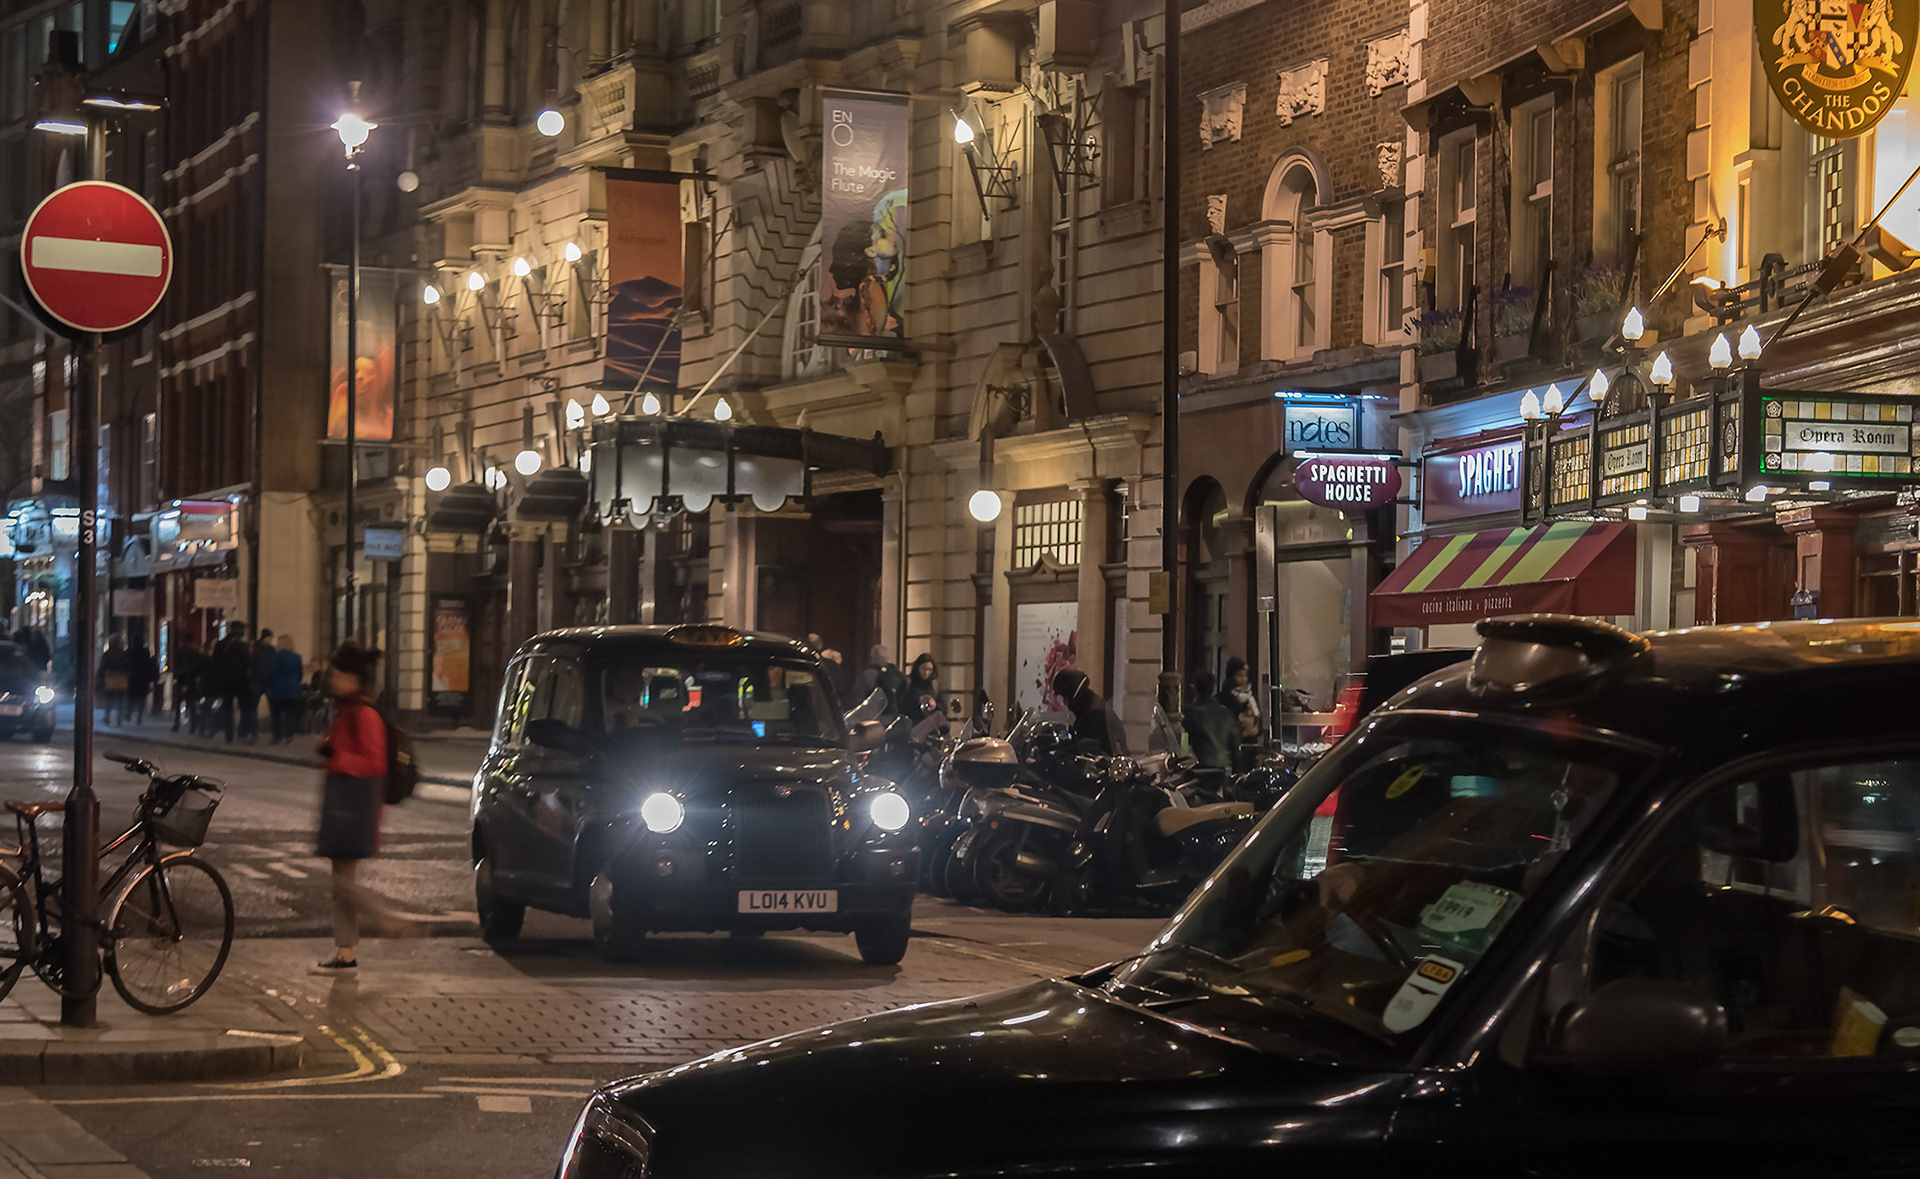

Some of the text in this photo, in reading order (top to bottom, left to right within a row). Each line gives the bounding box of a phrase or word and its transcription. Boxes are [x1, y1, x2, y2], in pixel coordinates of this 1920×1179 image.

[1783, 77, 1890, 130] CHANDOS
[1824, 95, 1851, 107] THE
[833, 162, 897, 183] The Magic
[831, 178, 865, 193] Flute
[1288, 416, 1351, 444] notes
[1800, 427, 1895, 446] Opera Room
[1310, 464, 1387, 484] SPAGHETTI
[1325, 483, 1372, 502] HOUSE
[1422, 598, 1442, 614] cucina
[1446, 596, 1473, 613] italiana
[1484, 592, 1512, 615] pizzeria
[794, 893, 827, 909] KVU
